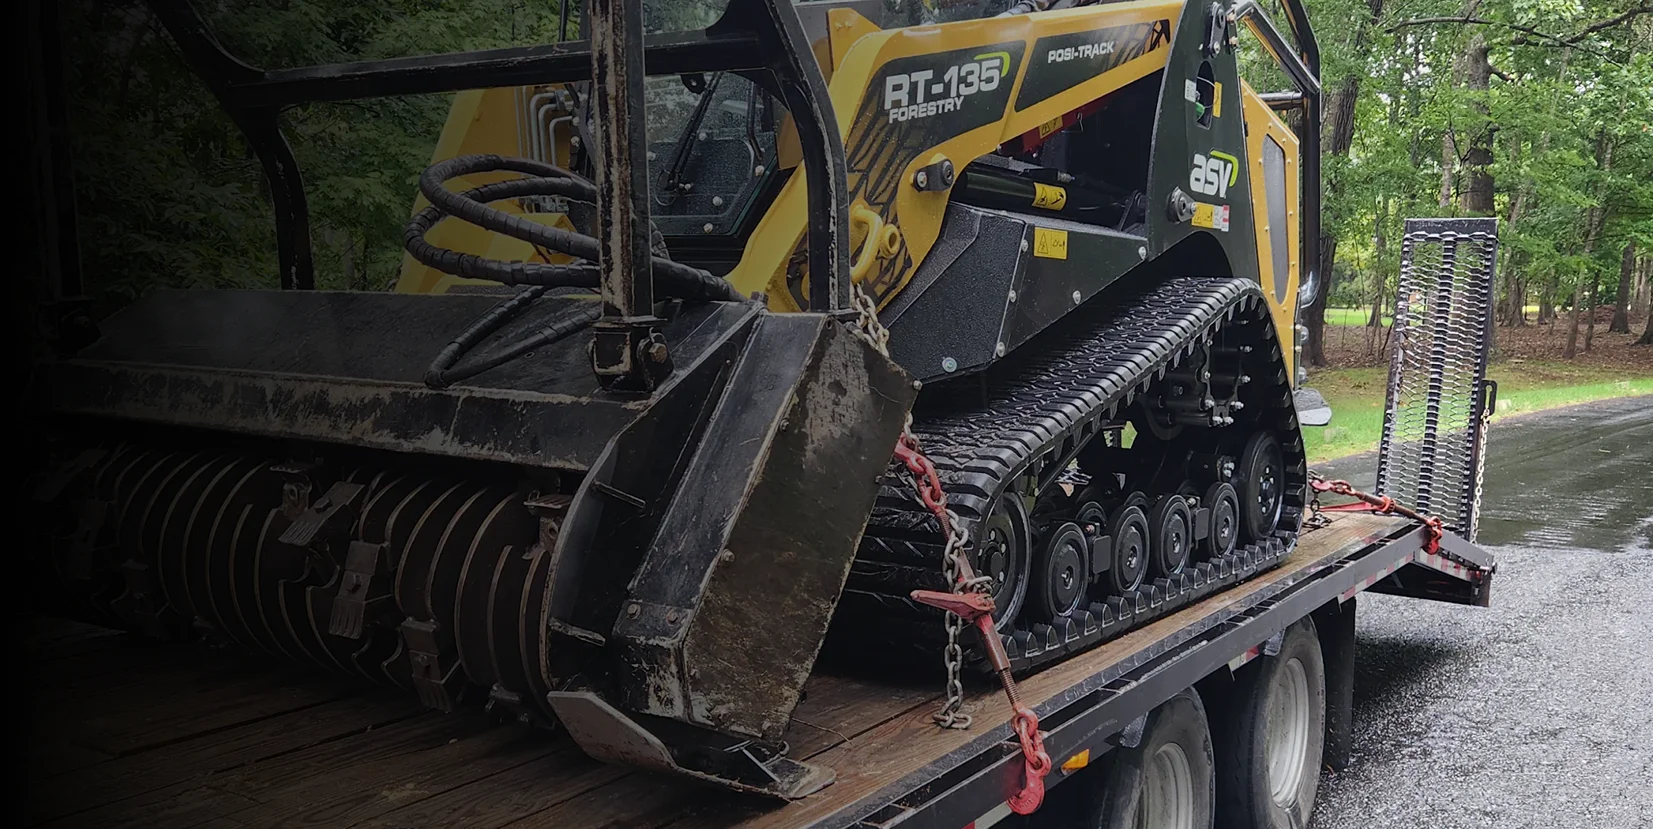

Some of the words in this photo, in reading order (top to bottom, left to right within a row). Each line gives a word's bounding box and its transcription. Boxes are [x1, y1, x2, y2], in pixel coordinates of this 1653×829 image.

[1047, 41, 1115, 64] POSI-TRACK
[884, 59, 1001, 110] RT-135
[888, 96, 964, 124] FORESTRY
[1189, 153, 1232, 198] asv
